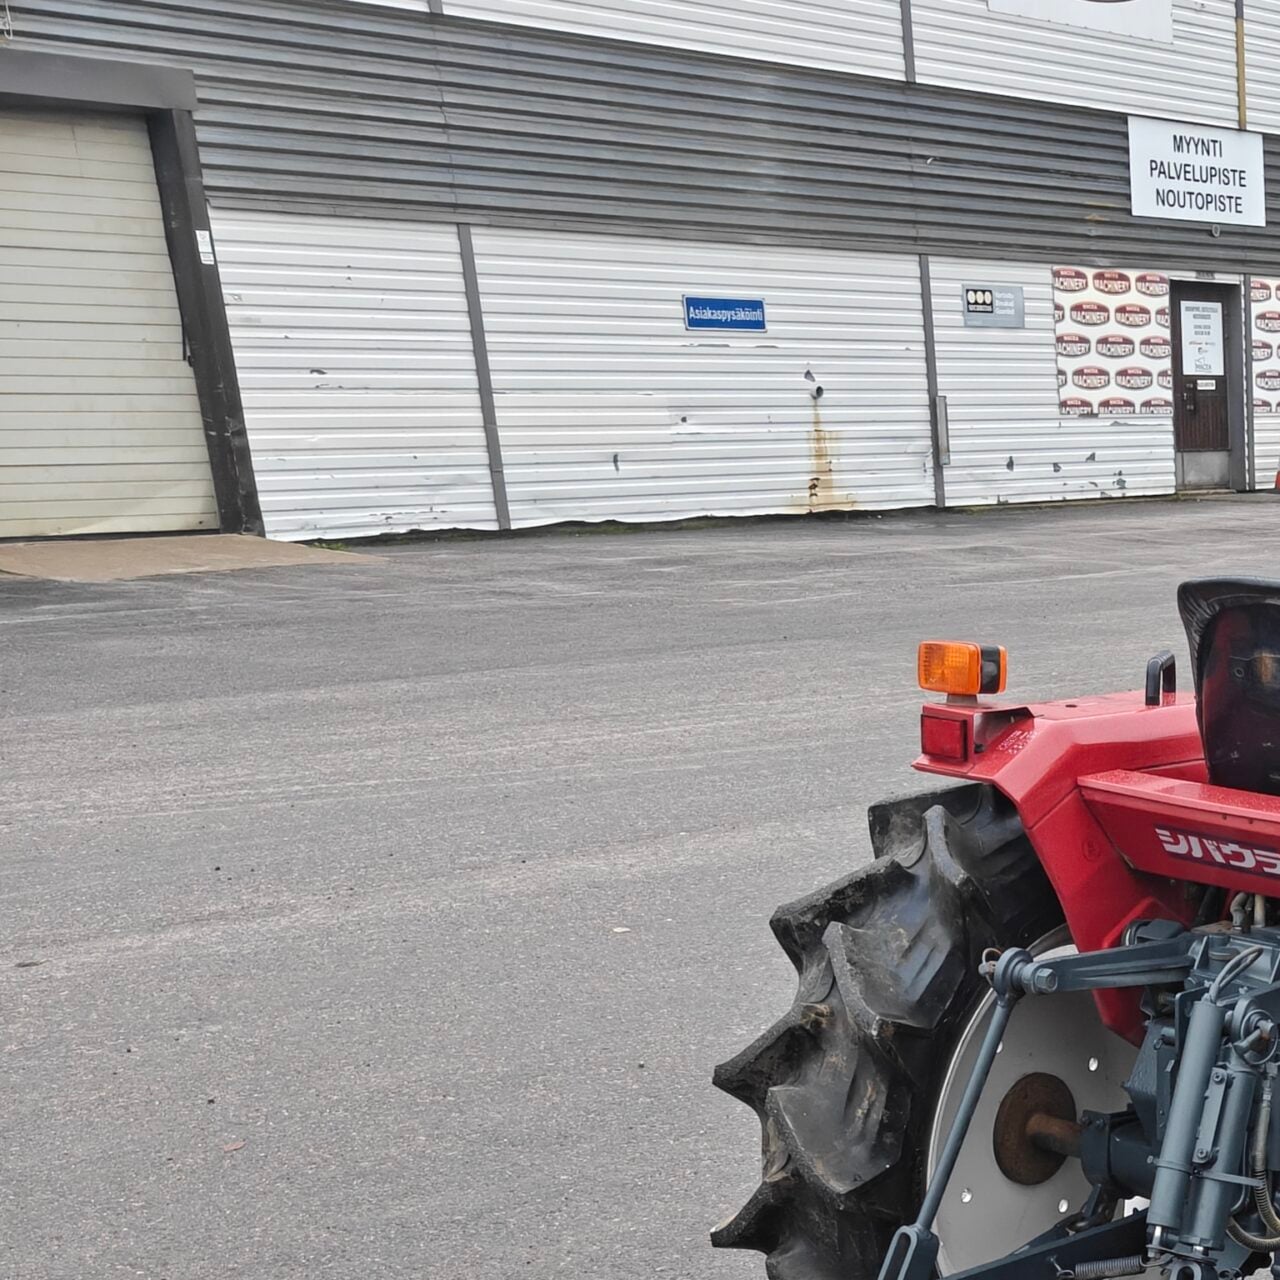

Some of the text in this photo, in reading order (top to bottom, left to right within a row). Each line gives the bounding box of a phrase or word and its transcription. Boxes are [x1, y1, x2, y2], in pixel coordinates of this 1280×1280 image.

[1173, 134, 1223, 158] MYYNTI
[1150, 159, 1247, 188] PALVELUPISTE
[1156, 188, 1244, 214] NOUTOPISTE
[689, 306, 763, 322] Asiakaspysäköinti
